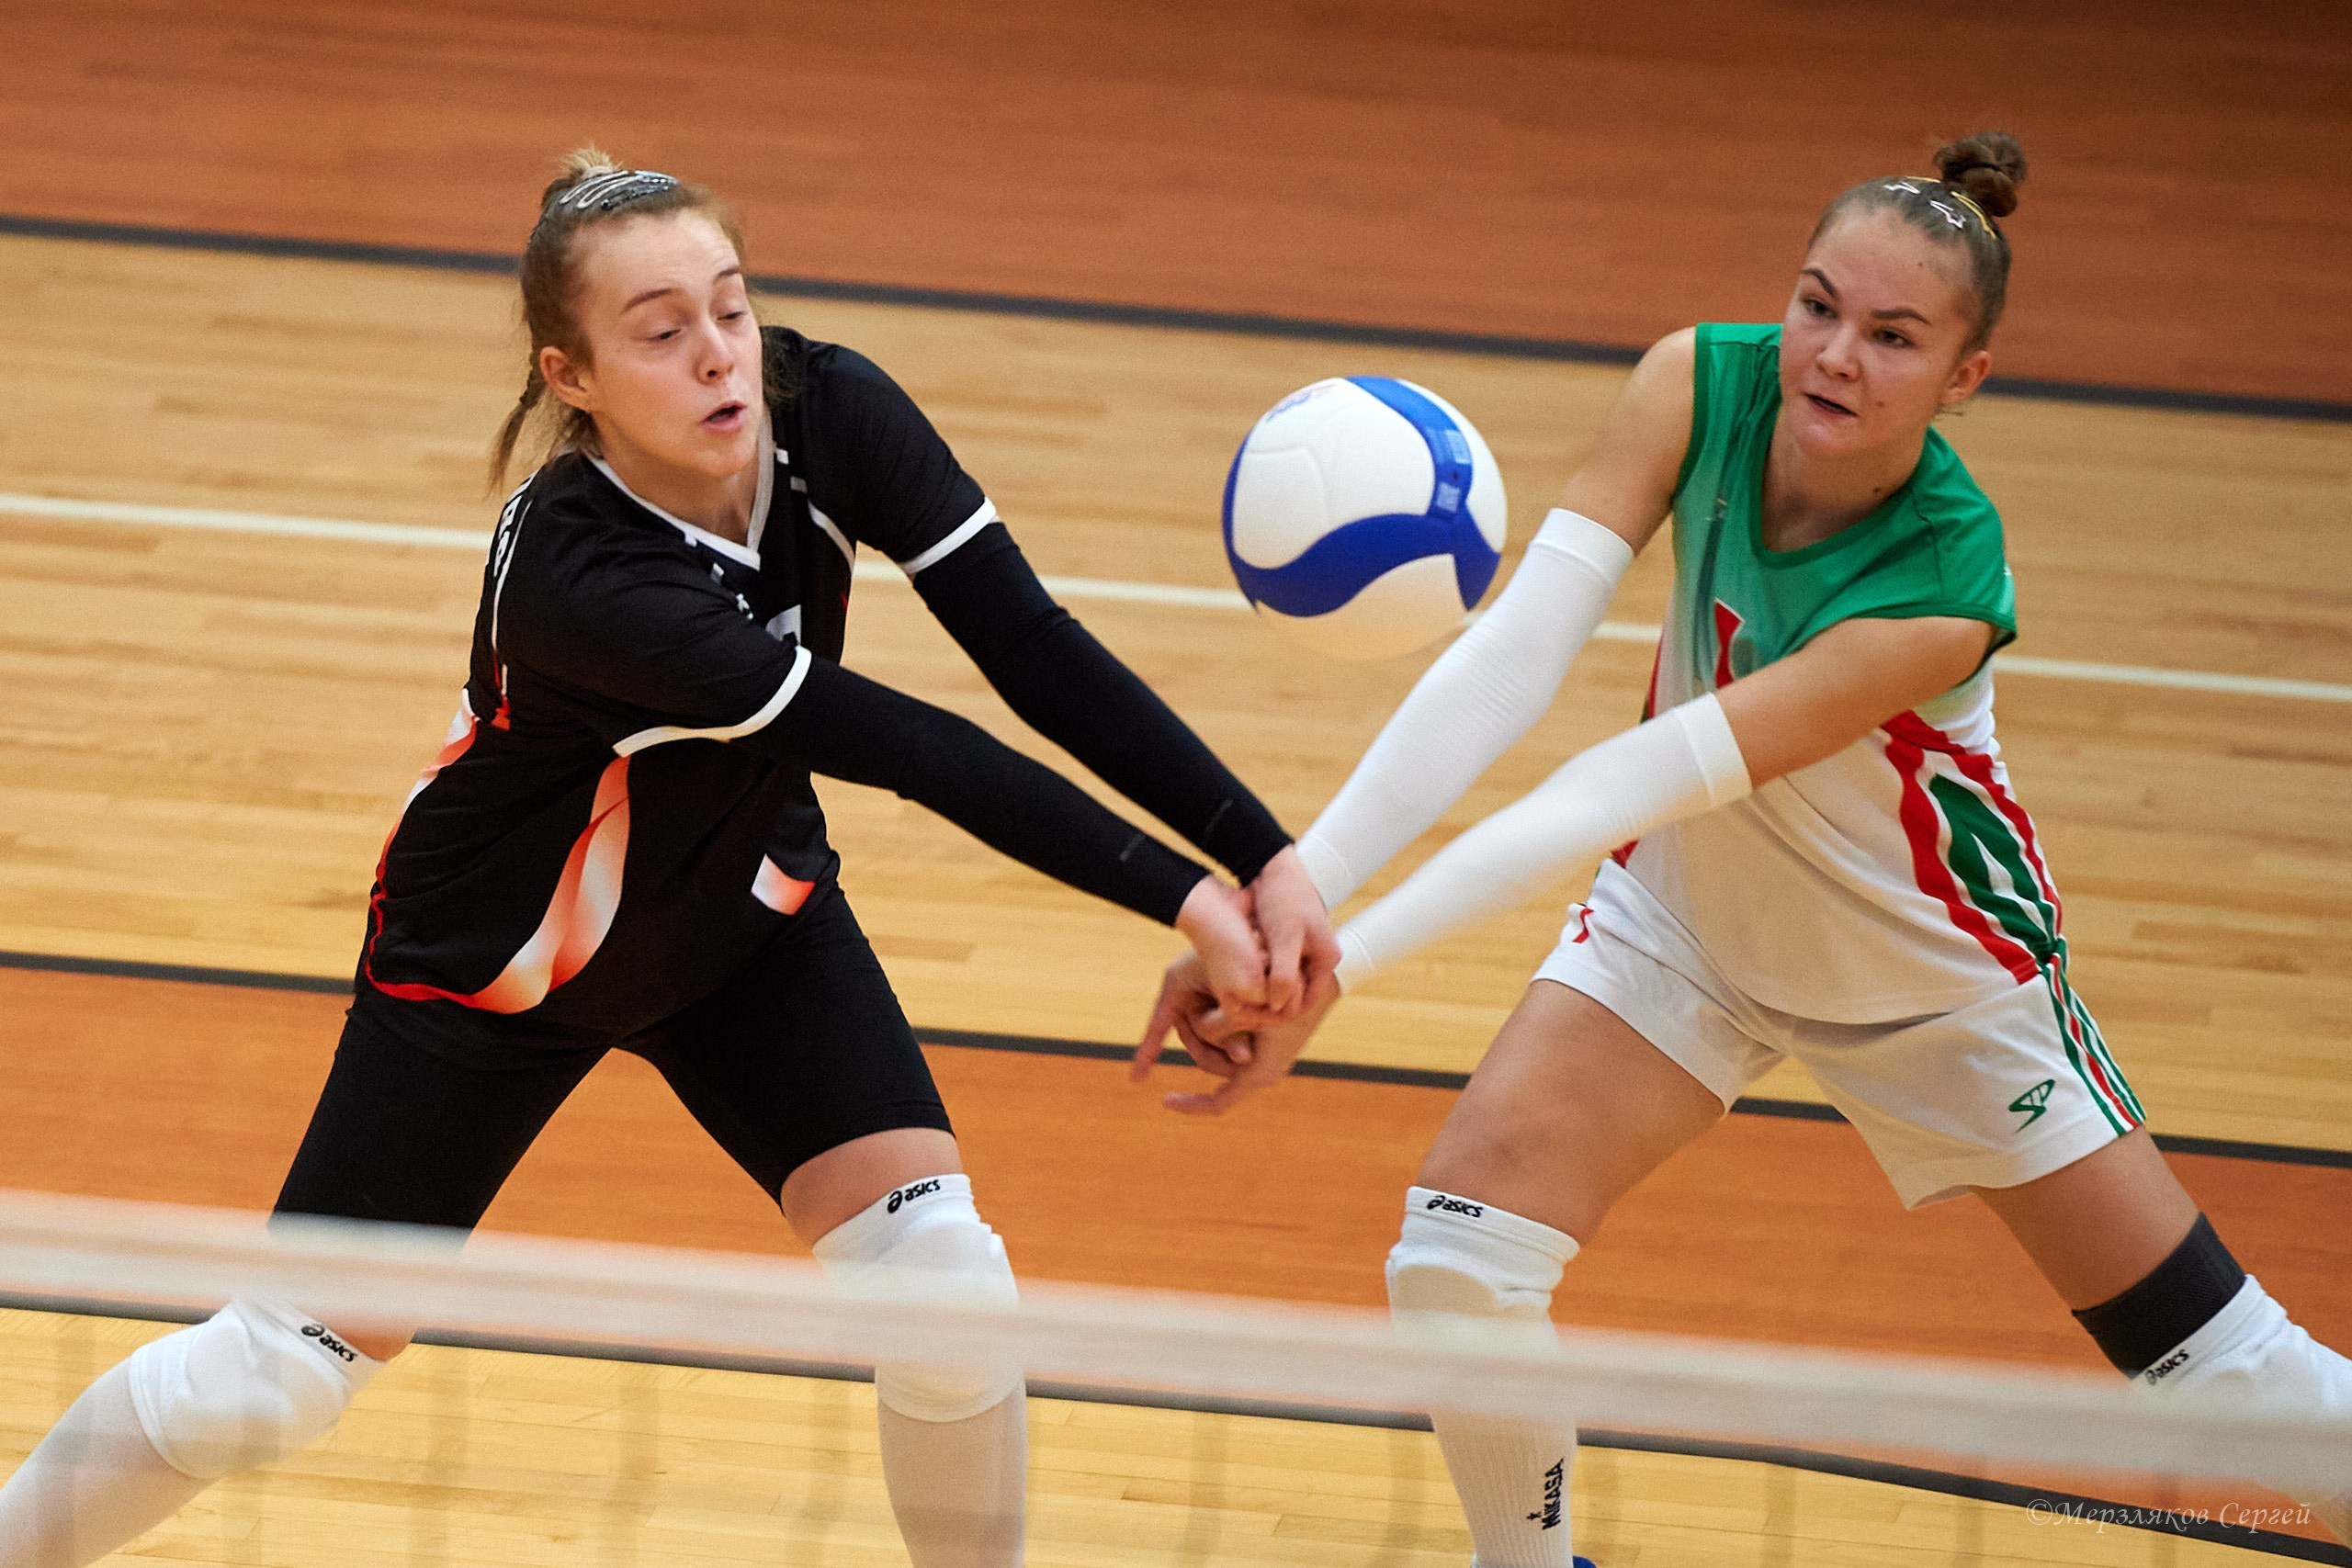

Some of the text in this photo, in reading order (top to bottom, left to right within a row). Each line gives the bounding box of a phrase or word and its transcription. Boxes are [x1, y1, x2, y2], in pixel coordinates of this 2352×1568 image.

[904, 1179, 942, 1202] asics
[1442, 1200, 1485, 1218] asics
[319, 1334, 358, 1362] asics
[2154, 1348, 2189, 1379] asics
[1541, 1457, 1564, 1531] MIKASA
